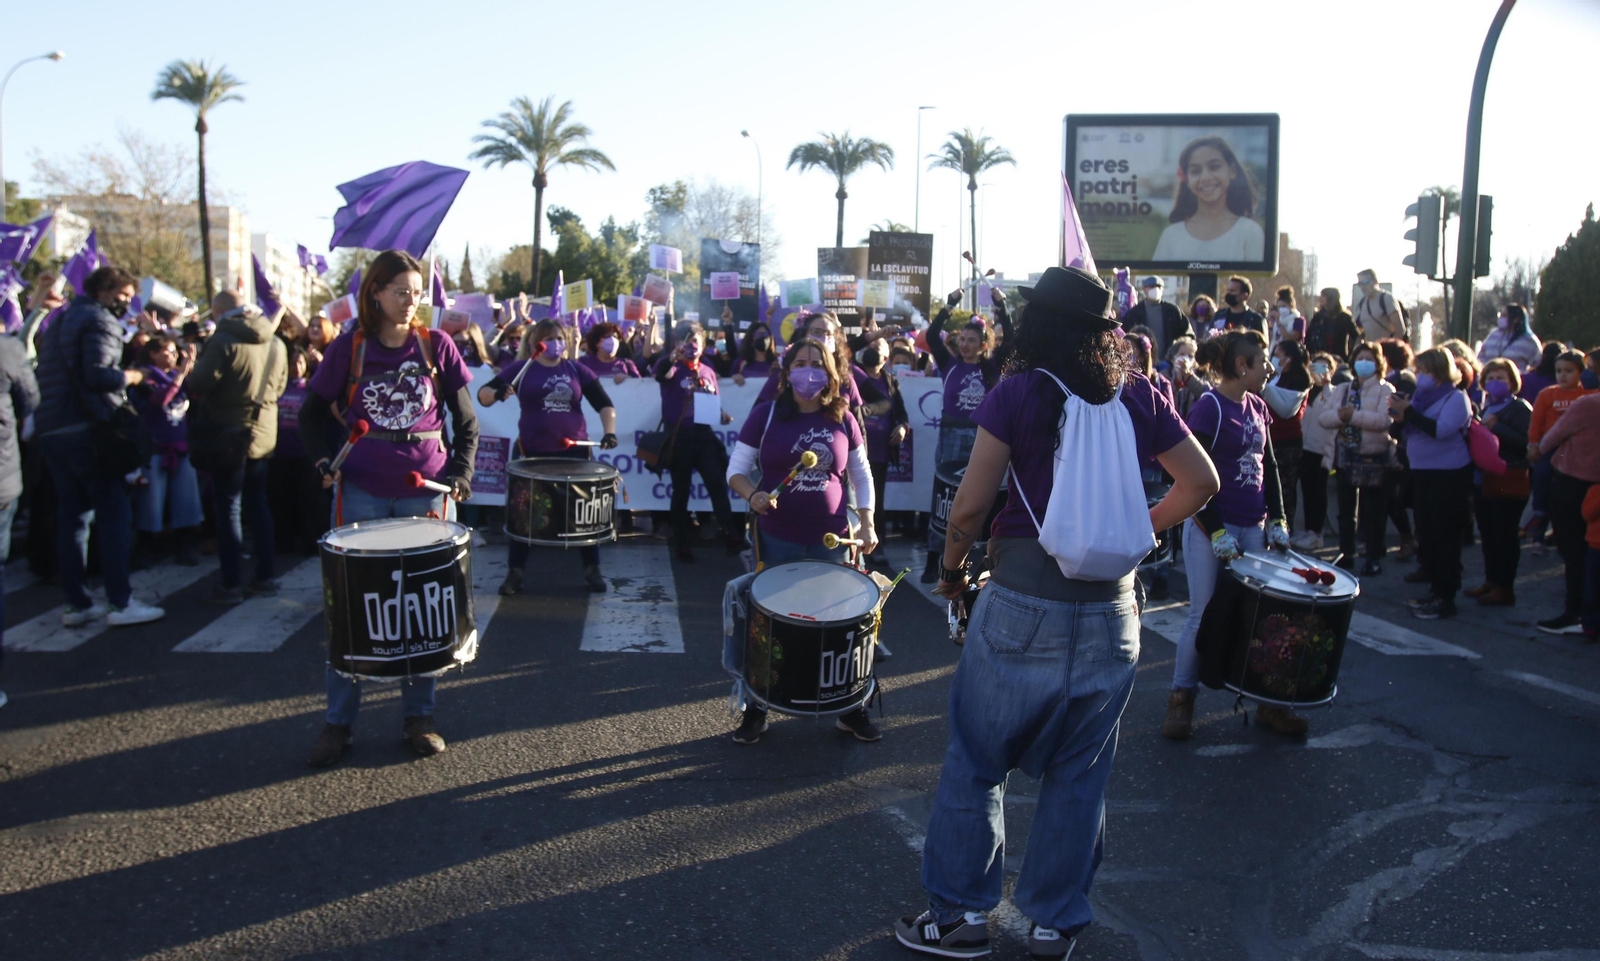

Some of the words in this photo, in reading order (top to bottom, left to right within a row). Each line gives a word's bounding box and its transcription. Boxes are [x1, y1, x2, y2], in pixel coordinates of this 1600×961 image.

[1079, 158, 1129, 173] eres
[1079, 174, 1138, 200] patri
[1078, 196, 1152, 216] monio
[871, 263, 882, 272] LA
[882, 264, 929, 275] ESCLAVITUD
[1187, 262, 1220, 270] JCDecaux
[888, 275, 910, 283] SIGUE
[839, 299, 857, 307] SIEND
[372, 642, 404, 655] sound
[409, 639, 442, 653] sister
